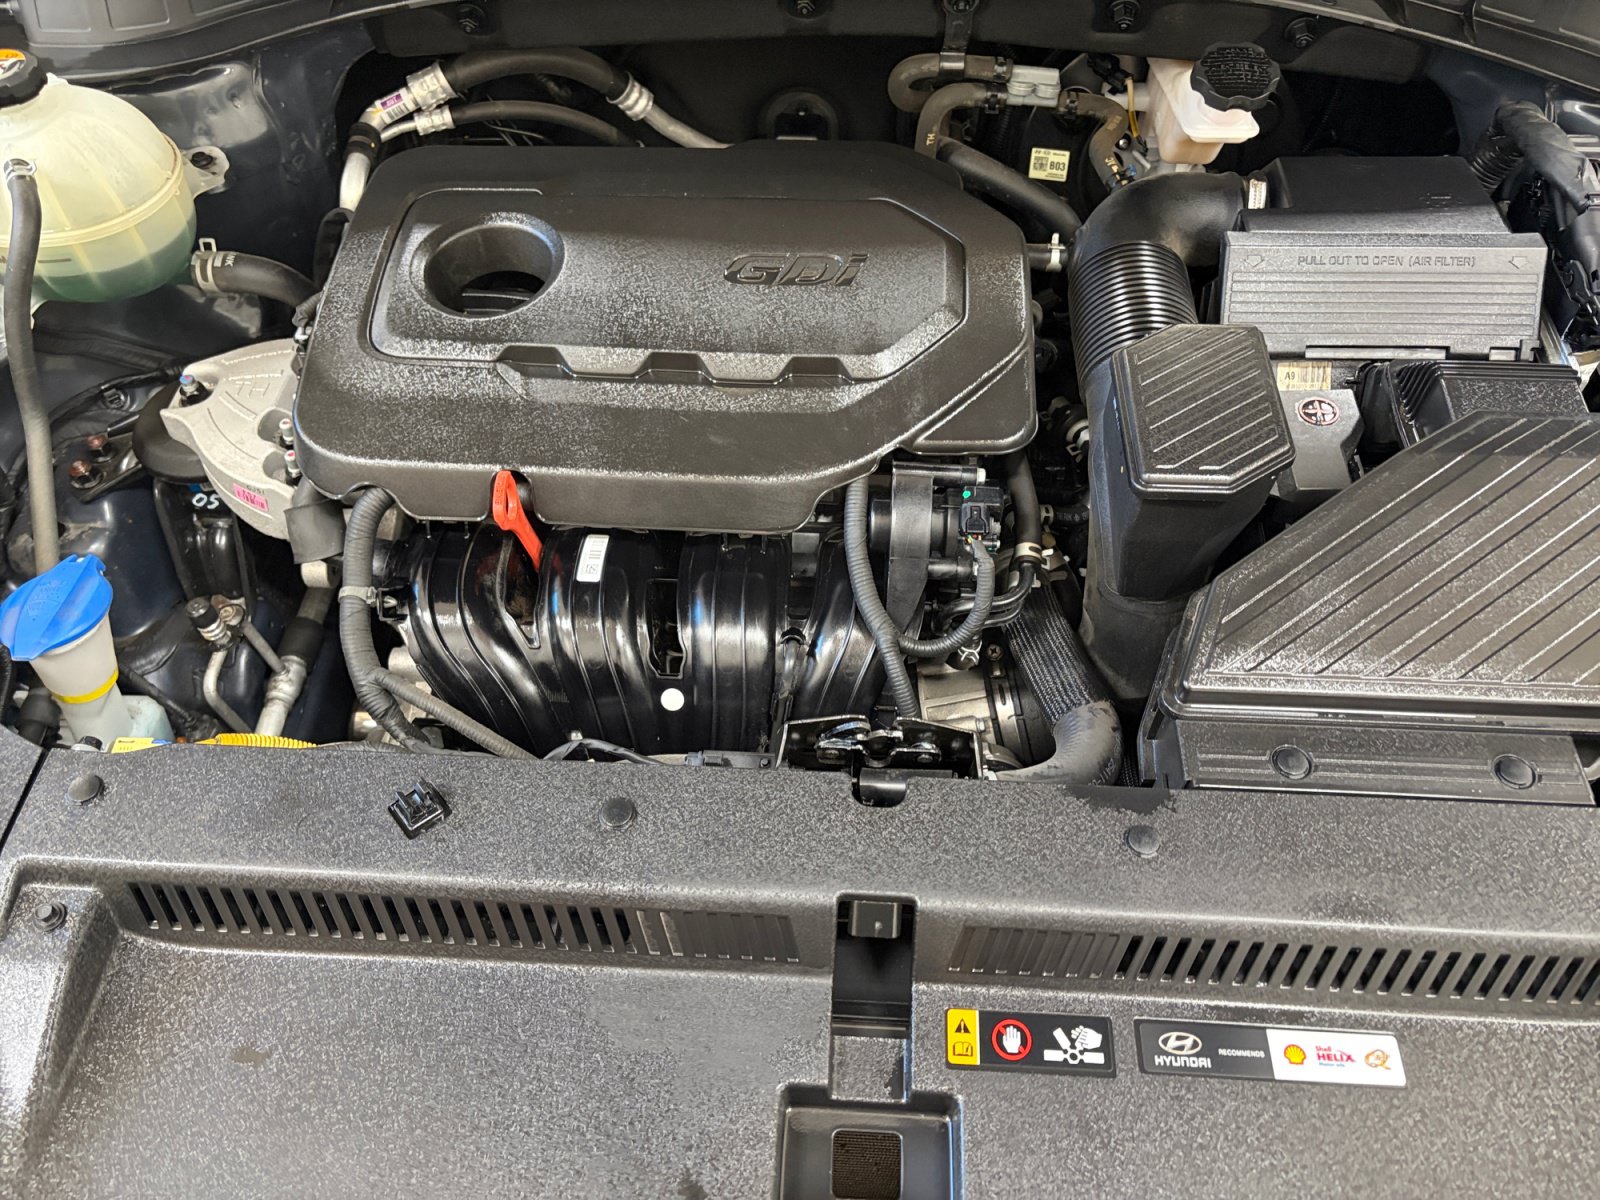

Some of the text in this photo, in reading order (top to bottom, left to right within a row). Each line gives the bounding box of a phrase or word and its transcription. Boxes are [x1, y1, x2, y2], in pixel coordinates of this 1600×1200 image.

[1049, 160, 1066, 172] B03
[1297, 255, 1476, 268] PULL OUT TO OPEN (AIR FILTER)
[723, 252, 869, 287] GDi
[1315, 1045, 1332, 1053] Shell
[1154, 1048, 1265, 1068] HYUNDAI RECOMMENDS
[1316, 1051, 1355, 1063] HELIX
